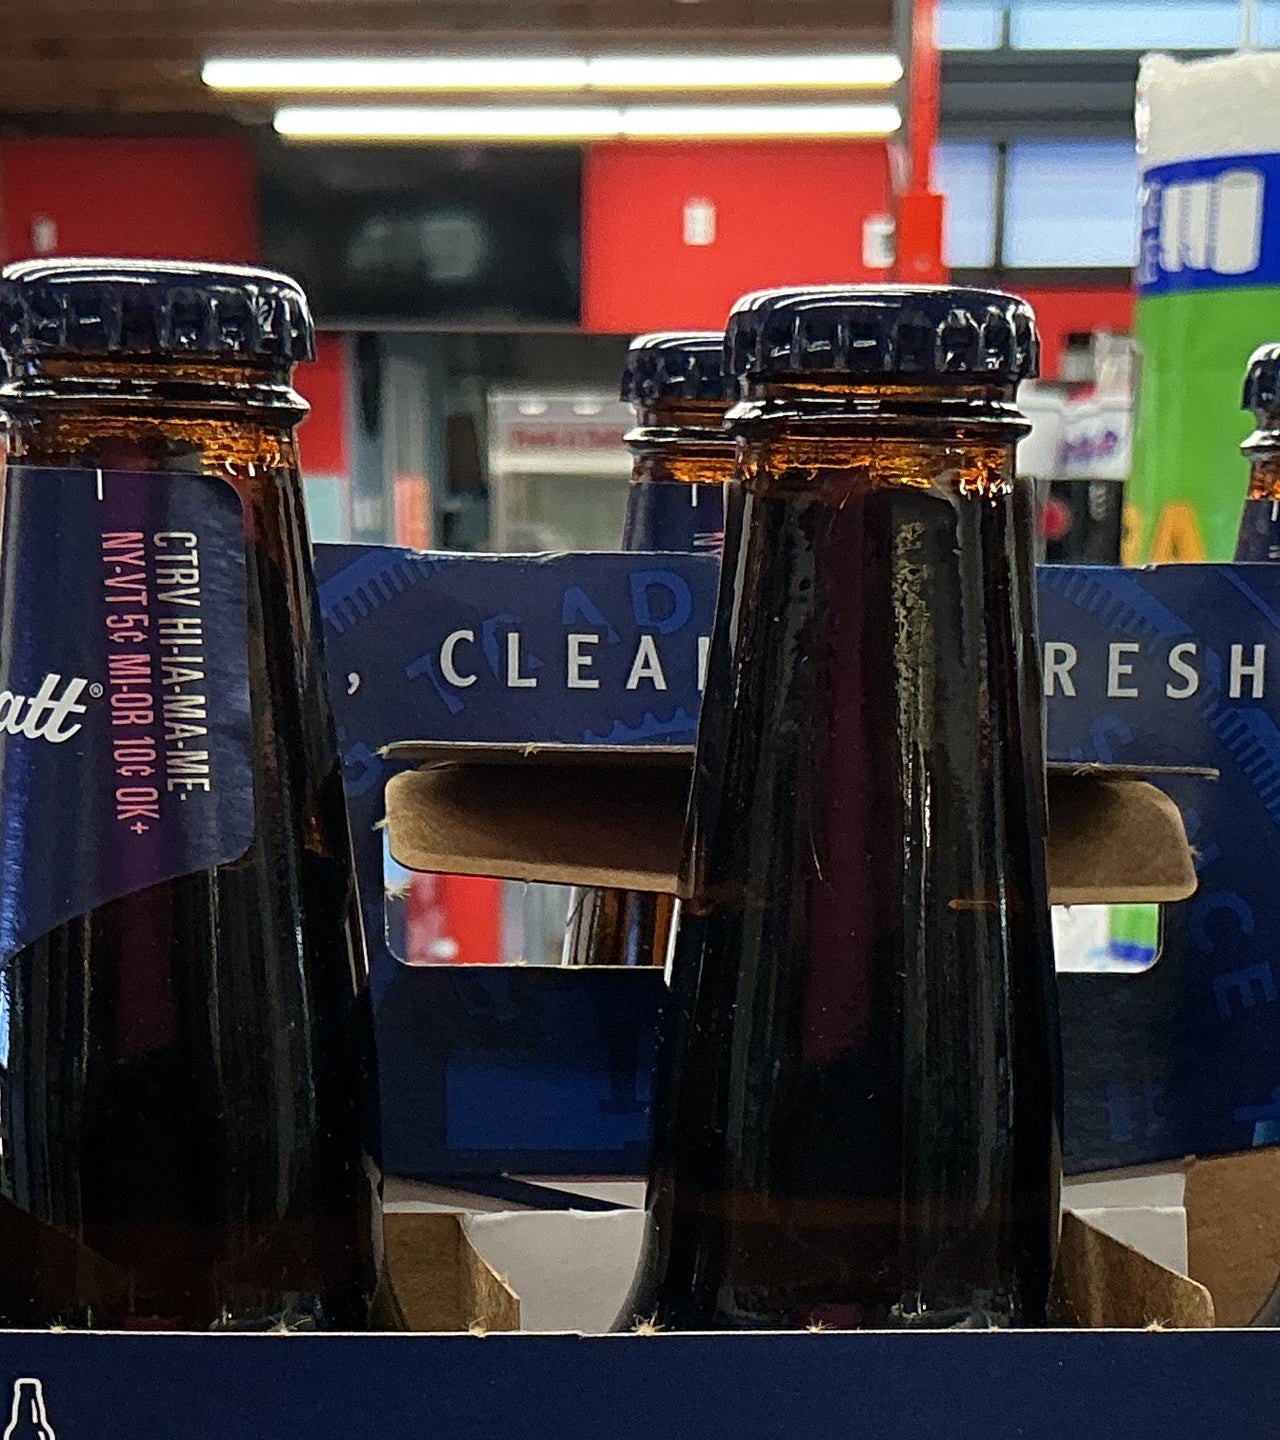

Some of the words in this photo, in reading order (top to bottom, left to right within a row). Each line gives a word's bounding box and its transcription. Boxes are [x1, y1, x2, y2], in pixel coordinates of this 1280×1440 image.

[101, 531, 148, 606] NY-VT
[106, 614, 149, 643] 5¢
[108, 654, 154, 725] MI-OR
[113, 736, 157, 776] 10¢
